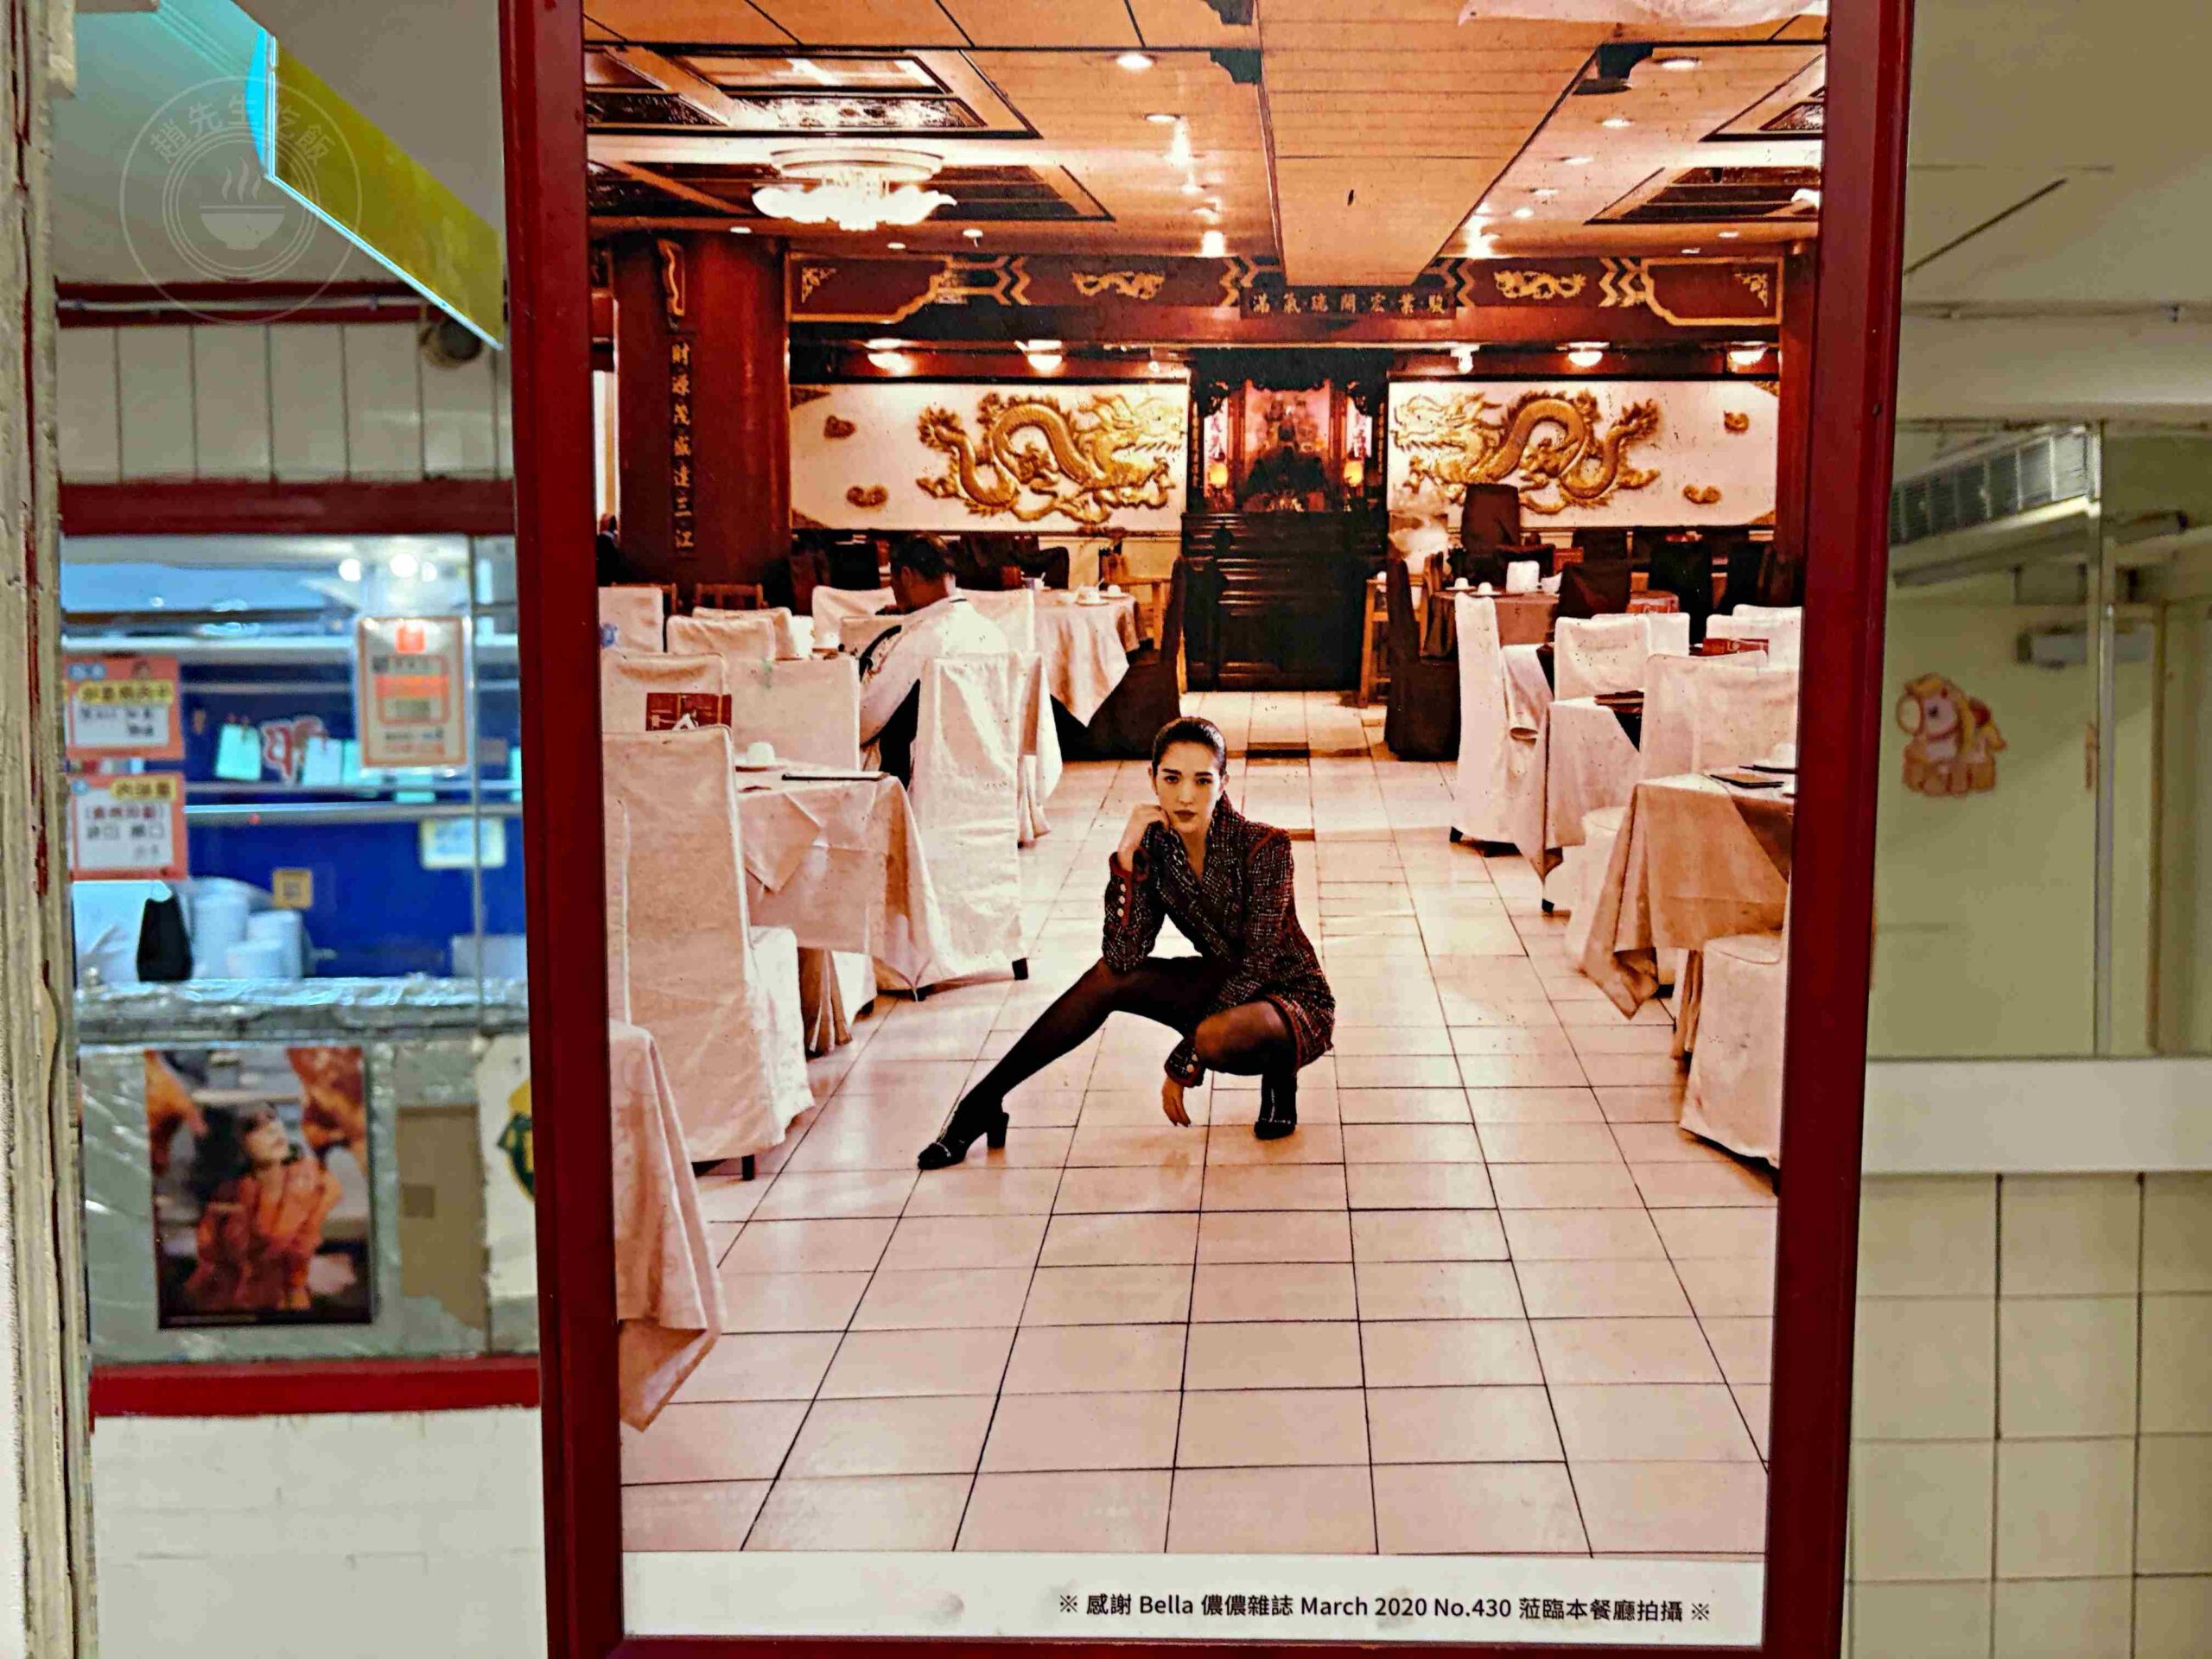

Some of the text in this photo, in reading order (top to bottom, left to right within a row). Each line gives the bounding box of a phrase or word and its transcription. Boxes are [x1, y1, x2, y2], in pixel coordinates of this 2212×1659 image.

[1086, 1593, 1683, 1623] 感謝 Bella 儂儂雜誌 March 2020 No.430 蒞臨本餐廳拍攝
